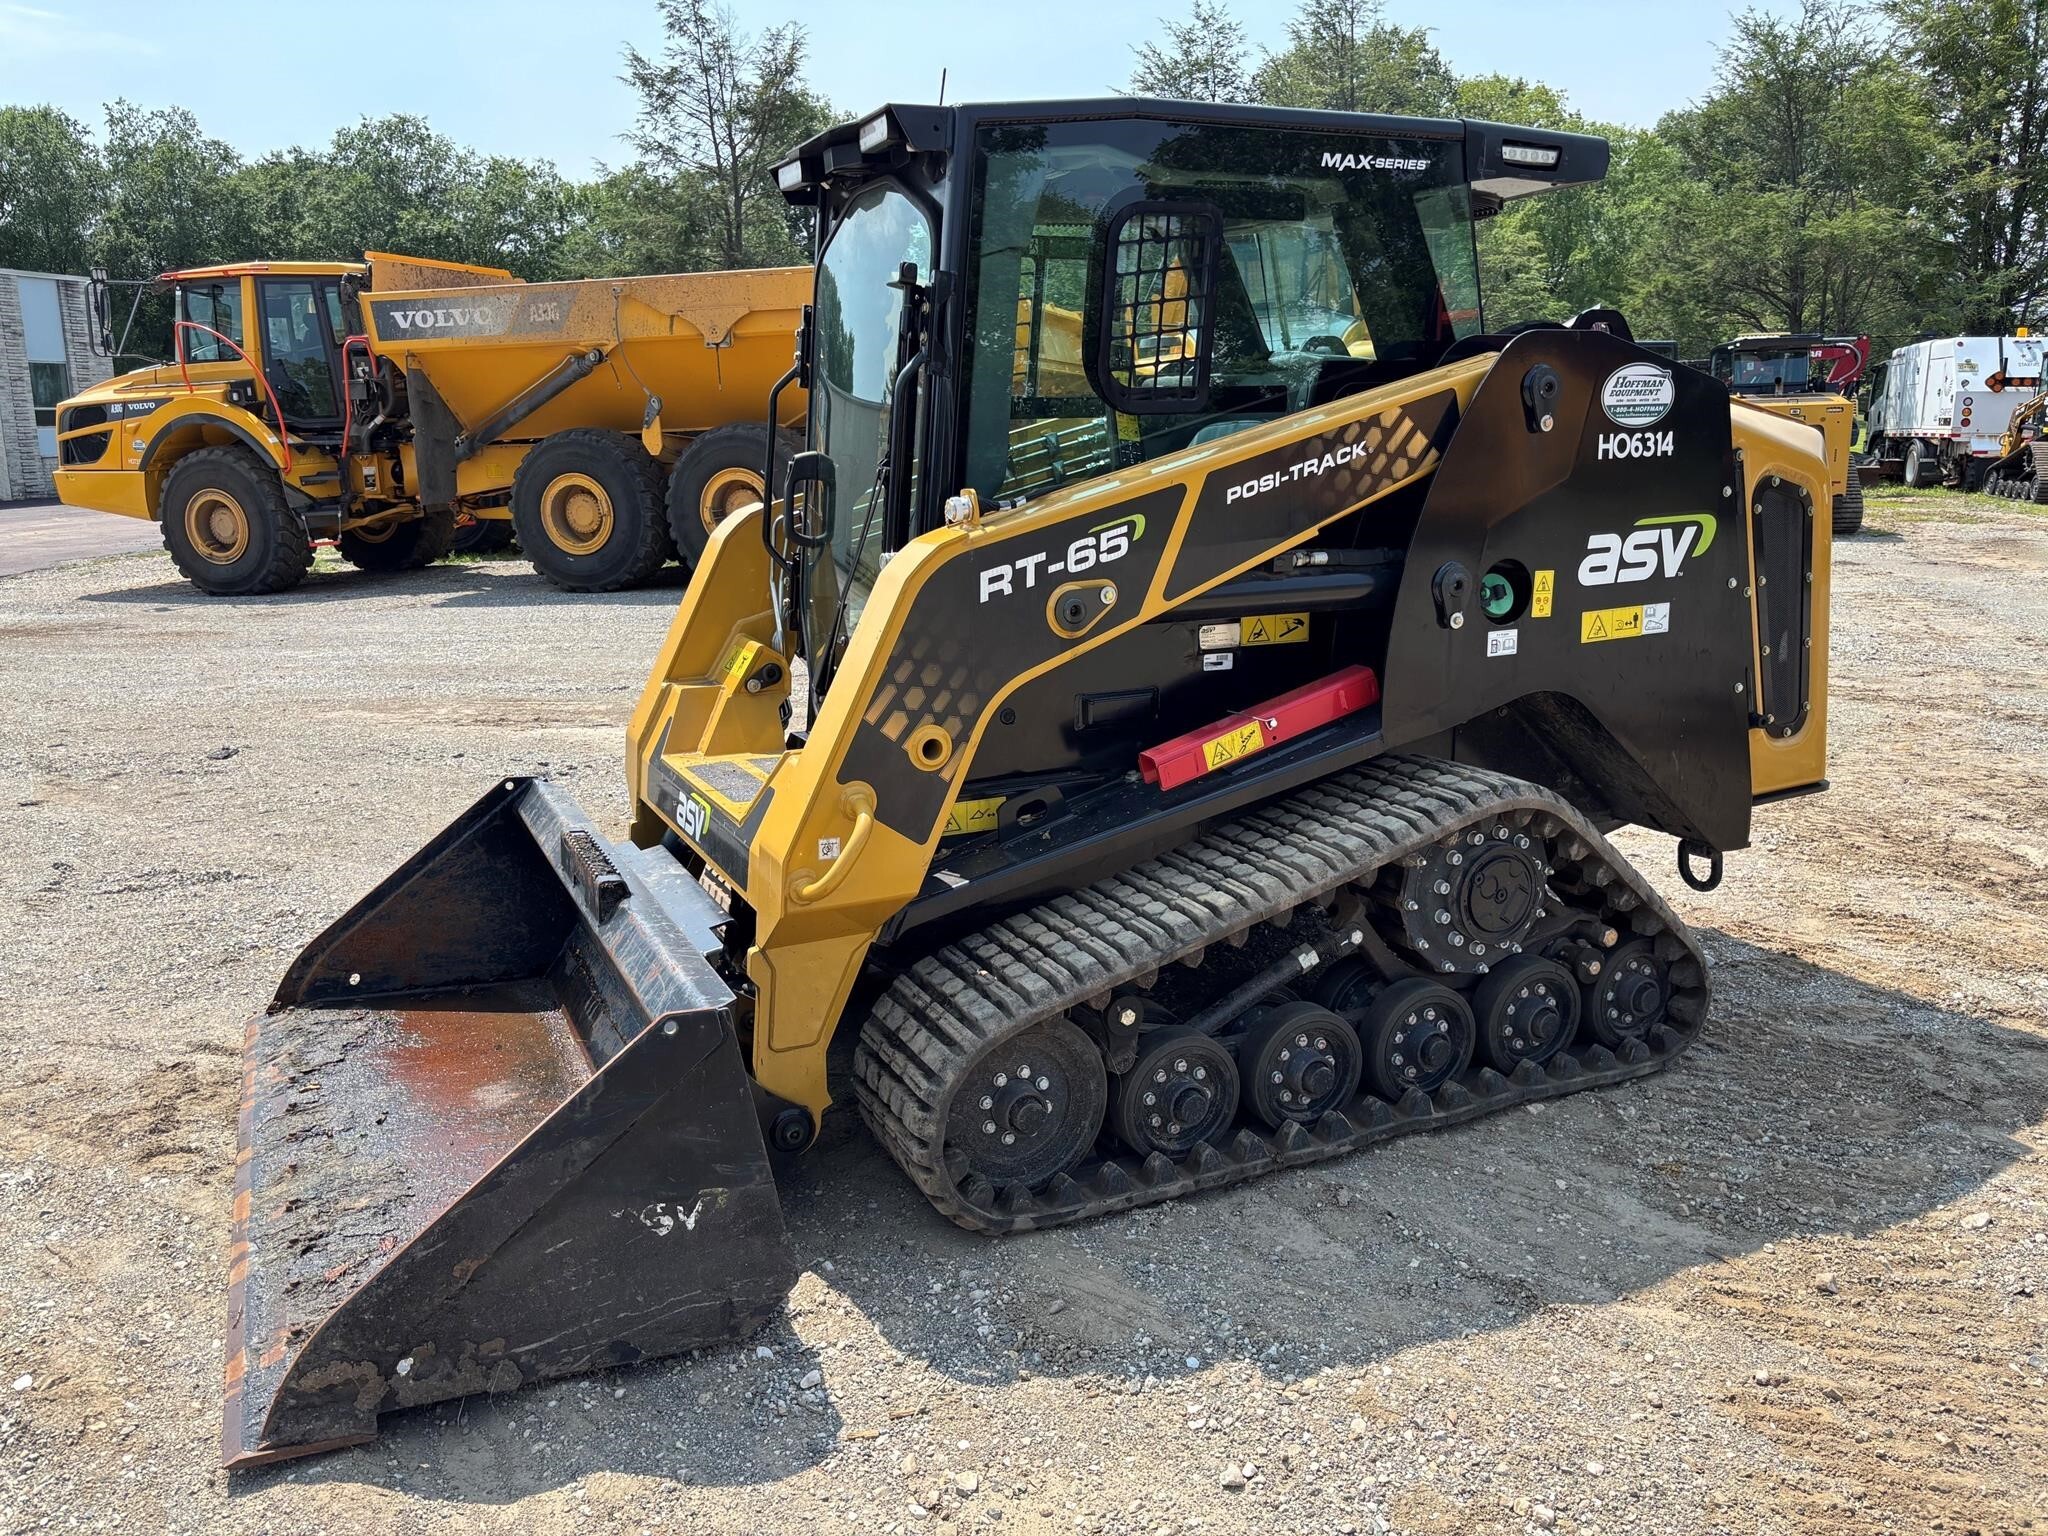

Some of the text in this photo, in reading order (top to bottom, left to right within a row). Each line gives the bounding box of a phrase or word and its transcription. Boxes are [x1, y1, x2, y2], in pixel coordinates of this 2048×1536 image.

[390, 307, 490, 329] VOLVO
[1609, 388, 1661, 397] EQUIPMENT
[1612, 376, 1665, 388] HOFFMAN
[128, 402, 155, 410] VOLVO
[1597, 431, 1674, 460] HO6314
[1226, 440, 1367, 504] POSI-TRACK
[980, 525, 1129, 603] RT-65
